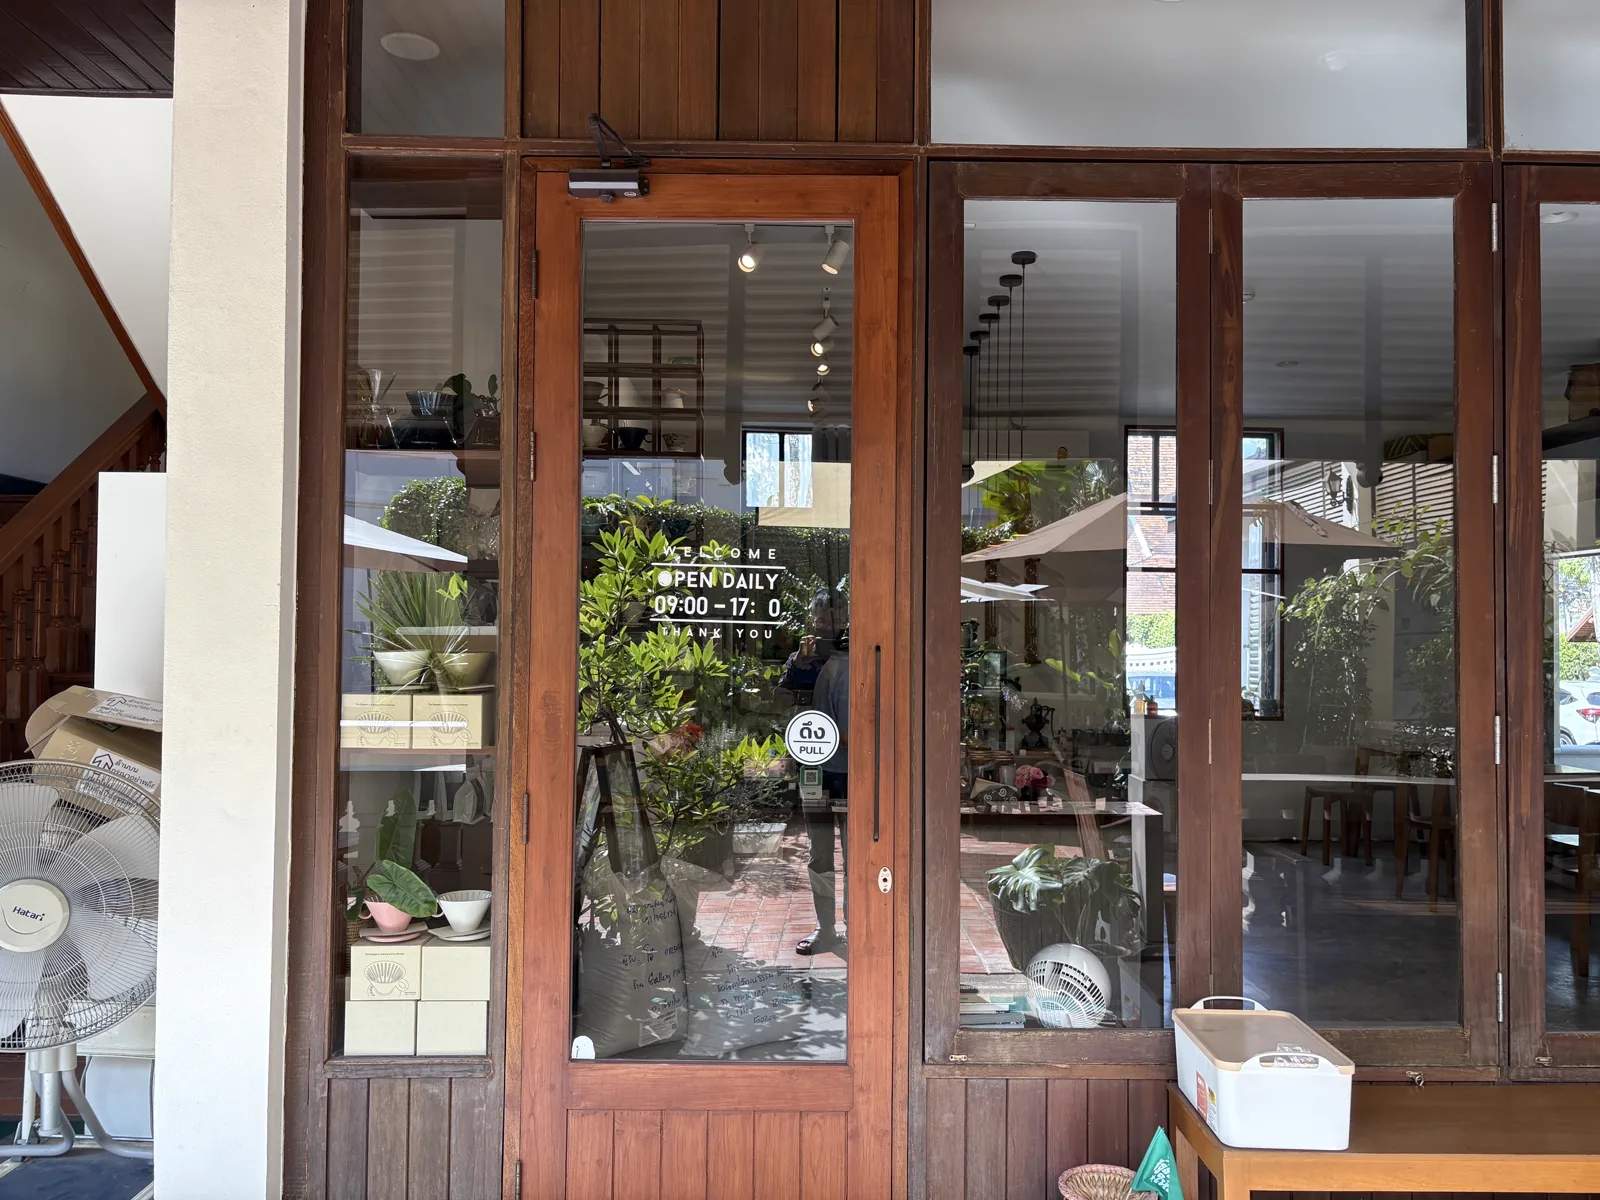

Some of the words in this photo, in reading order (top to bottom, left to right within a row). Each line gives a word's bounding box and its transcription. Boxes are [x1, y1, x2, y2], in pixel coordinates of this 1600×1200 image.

[662, 545, 777, 560] WELCOME
[722, 572, 780, 590] DAILY
[654, 595, 709, 616] 09:00
[661, 626, 721, 639] THANK
[735, 628, 773, 639] YOU
[799, 721, 826, 740] ดึง
[799, 746, 825, 755] PULL
[115, 759, 139, 773] ด้านบน
[12, 906, 46, 921] Hatari
